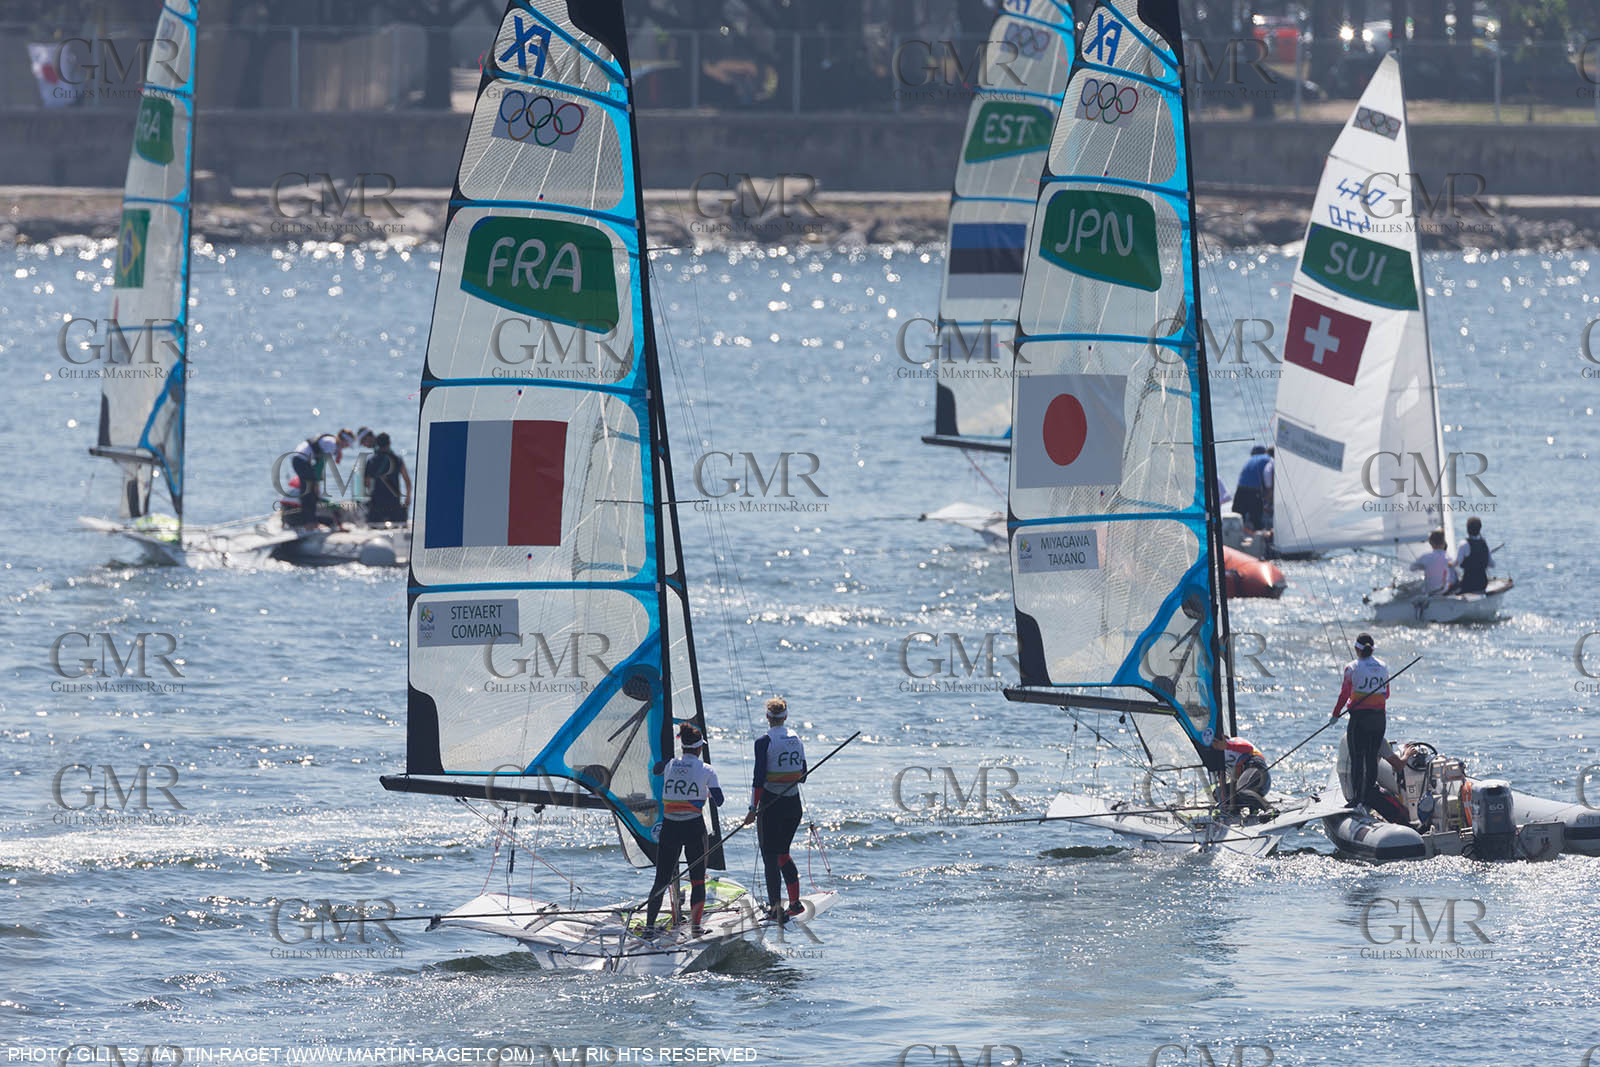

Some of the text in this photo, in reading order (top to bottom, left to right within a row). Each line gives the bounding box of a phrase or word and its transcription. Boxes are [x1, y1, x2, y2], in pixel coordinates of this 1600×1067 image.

[984, 113, 1037, 146] EST
[1055, 208, 1134, 256] JPN
[487, 236, 582, 293] FRA
[1323, 240, 1388, 287] SUI
[1040, 535, 1091, 551] MIYAGAWA
[1047, 551, 1087, 566] TAKANO
[450, 604, 503, 620] STEYAERT
[451, 623, 502, 639] COMPAN
[664, 779, 700, 797] FRA
